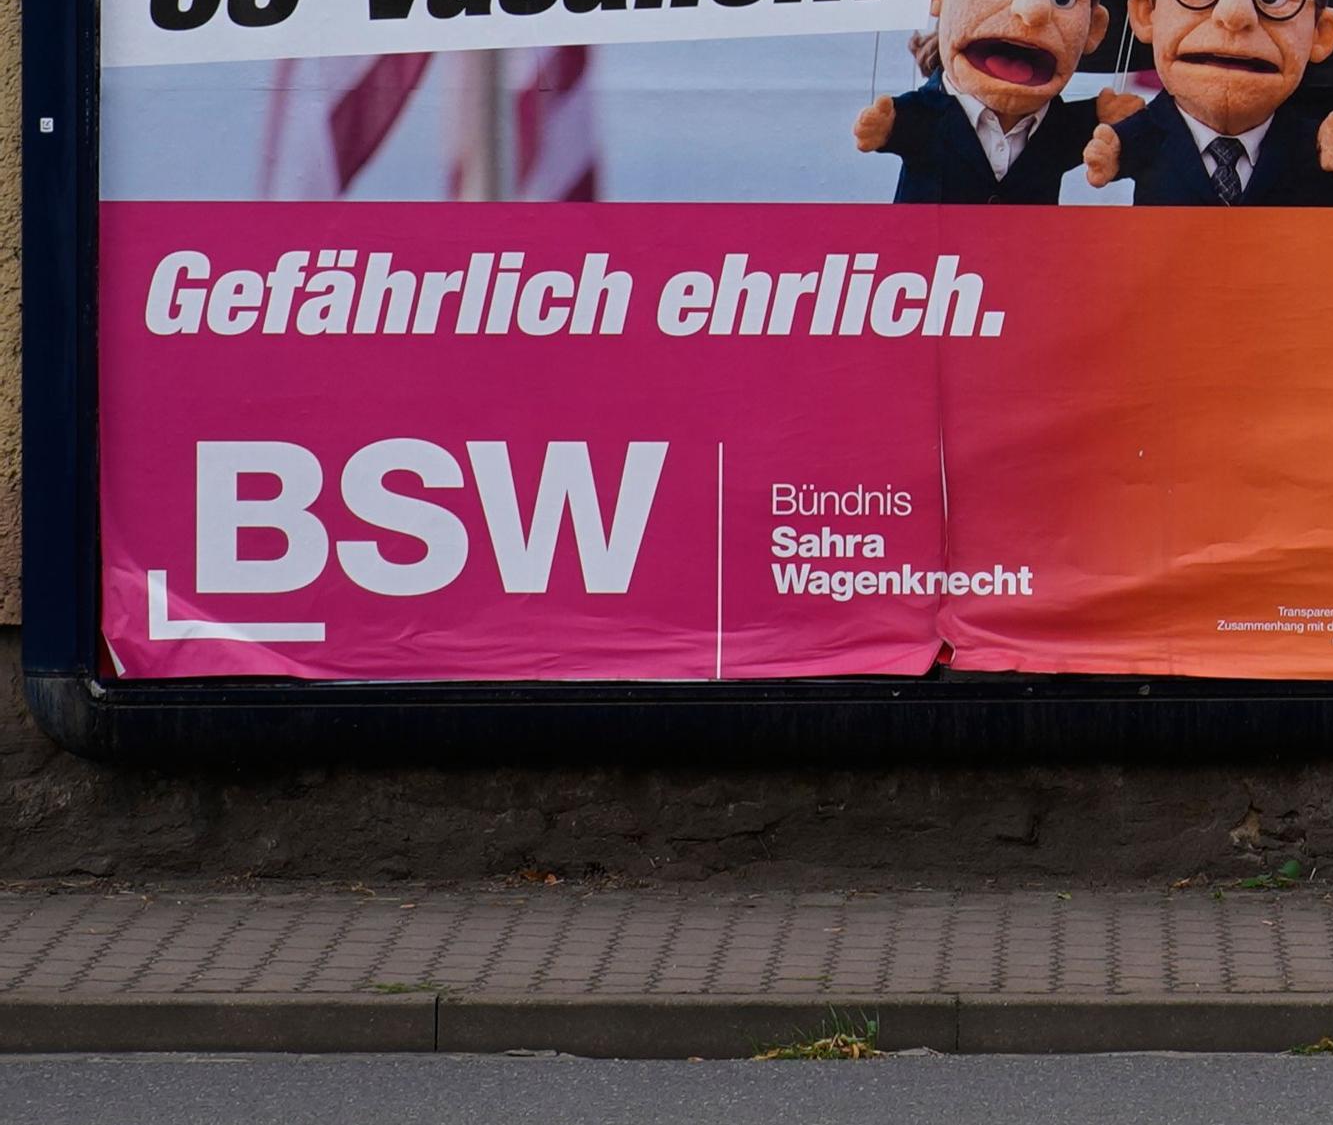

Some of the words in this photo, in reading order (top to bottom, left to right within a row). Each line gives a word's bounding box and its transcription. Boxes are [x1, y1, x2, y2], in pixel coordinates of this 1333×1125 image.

[145, 250, 632, 337] Gefährlich
[656, 253, 1004, 338] ehrlich.
[196, 438, 669, 596] BSW
[771, 483, 912, 517] Bündnis
[771, 526, 884, 559] Sahra
[771, 563, 1032, 603] Wagenknecht
[1216, 619, 1305, 634] Zusammenhang
[1306, 620, 1325, 632] mit
